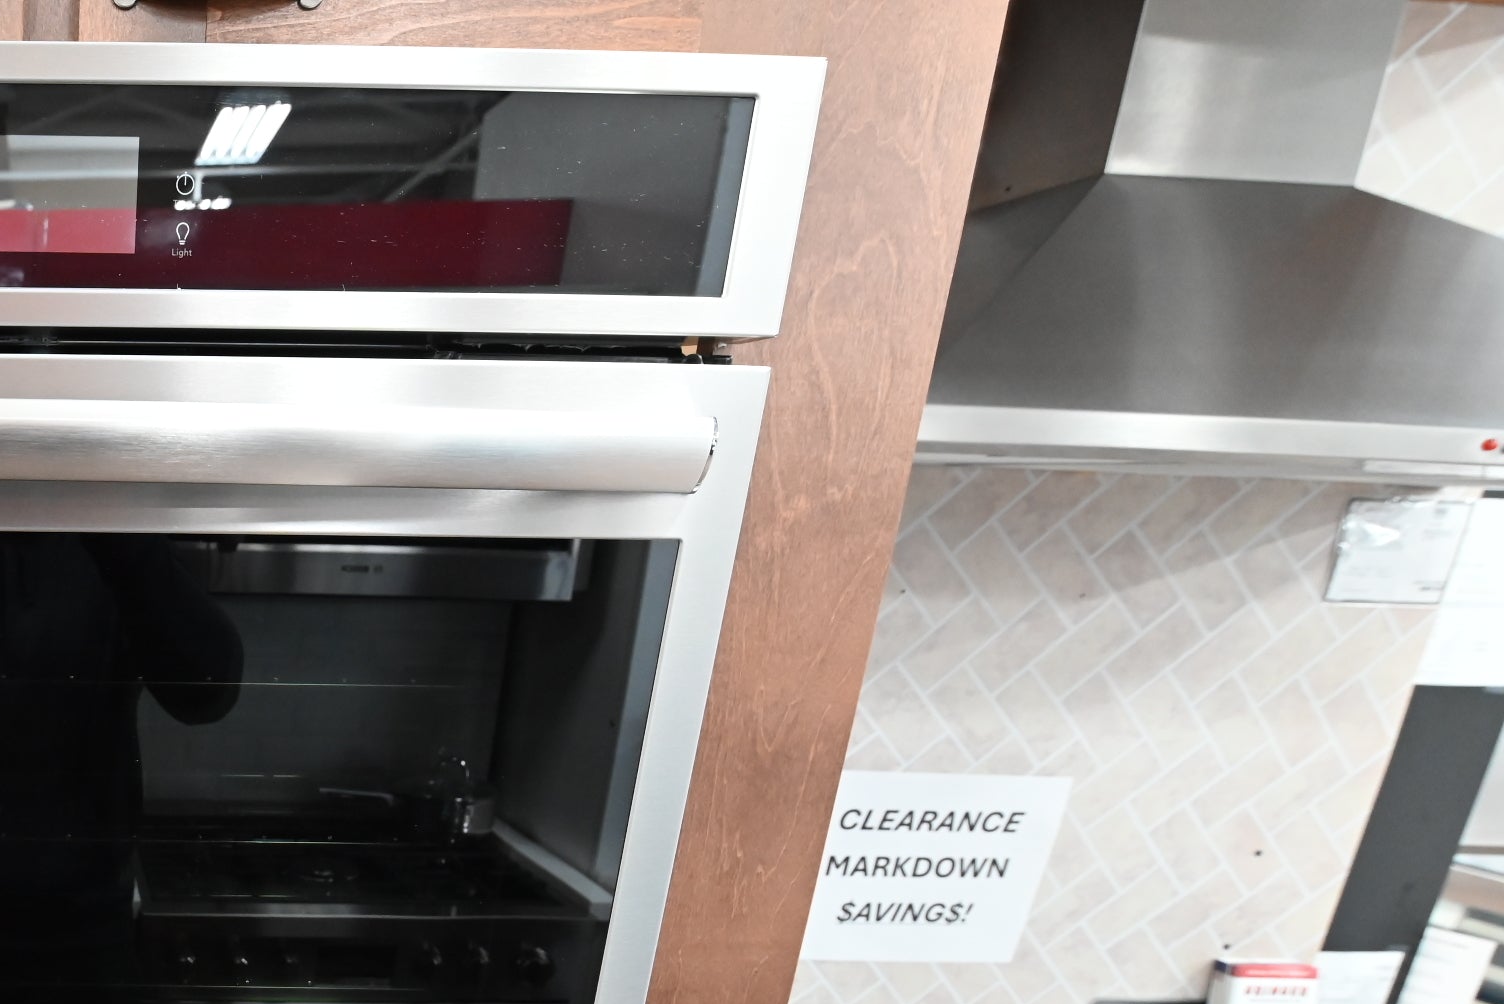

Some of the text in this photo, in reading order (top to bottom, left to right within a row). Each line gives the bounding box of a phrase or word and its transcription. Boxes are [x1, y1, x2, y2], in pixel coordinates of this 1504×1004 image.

[171, 248, 193, 259] Light
[839, 808, 1026, 833] CLEARANCE
[824, 855, 1010, 879] MARKDOWN
